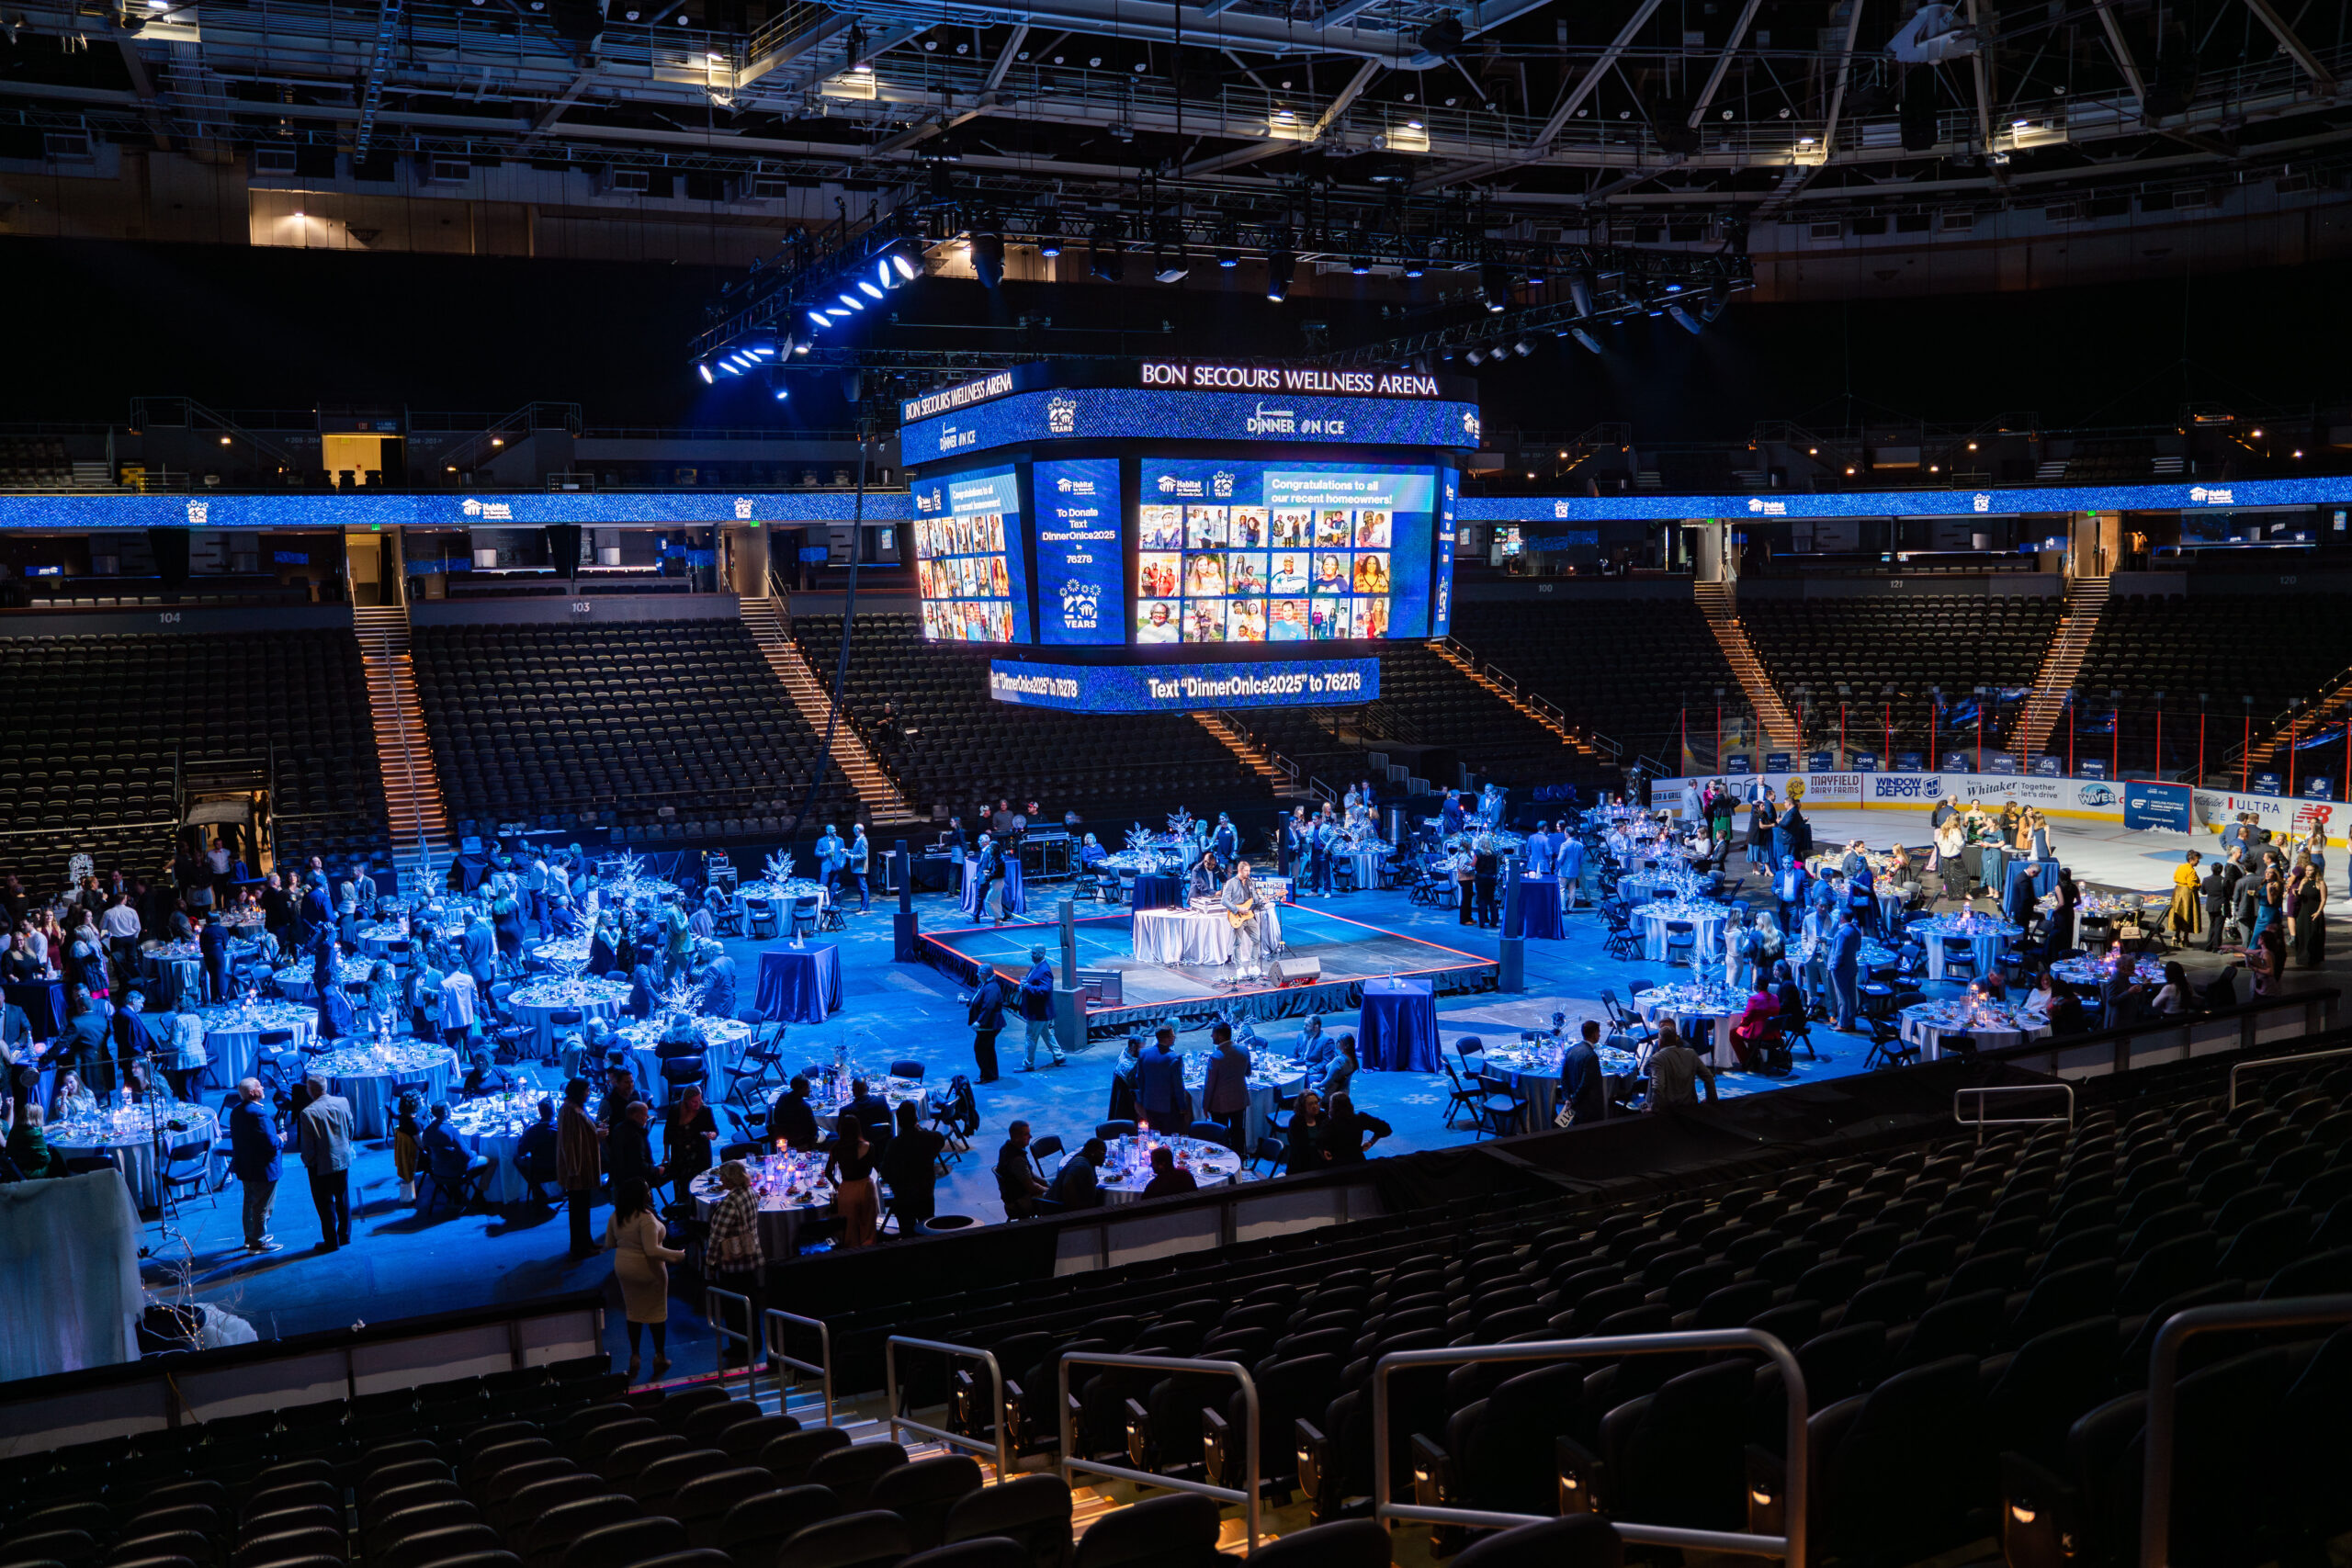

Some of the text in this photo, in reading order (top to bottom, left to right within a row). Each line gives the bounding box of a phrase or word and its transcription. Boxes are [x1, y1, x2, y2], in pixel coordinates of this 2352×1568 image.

[1142, 365, 1439, 395] BON SECOURS WELLNESS ARENA
[906, 372, 1012, 420] BON SECOURS WELLNESS ARENA
[1325, 420, 1344, 434] ICE
[1272, 479, 1378, 491] Congratulations to all
[1272, 494, 1393, 504] our recent homeowners!
[1057, 508, 1098, 517] To Donate
[1069, 520, 1088, 528] Text
[1043, 531, 1115, 540] DinnerOnIce2025
[1067, 555, 1092, 563] 76278
[571, 603, 590, 613] 103
[159, 613, 181, 623] 104
[1065, 620, 1096, 628] YEARS
[1049, 681, 1056, 695] to
[1056, 679, 1078, 698] 76278
[1148, 672, 1361, 698] Text “DinnerOnIce2025” to 76278
[1811, 775, 1860, 785] MAYFIELD
[1875, 777, 1921, 786] WINDOW
[1875, 786, 1918, 797] DEPOT
[1967, 781, 2018, 796] Whitaker
[2021, 783, 2055, 791] Together
[2078, 794, 2115, 805] WAVES
[2237, 799, 2279, 814] ULTRA
